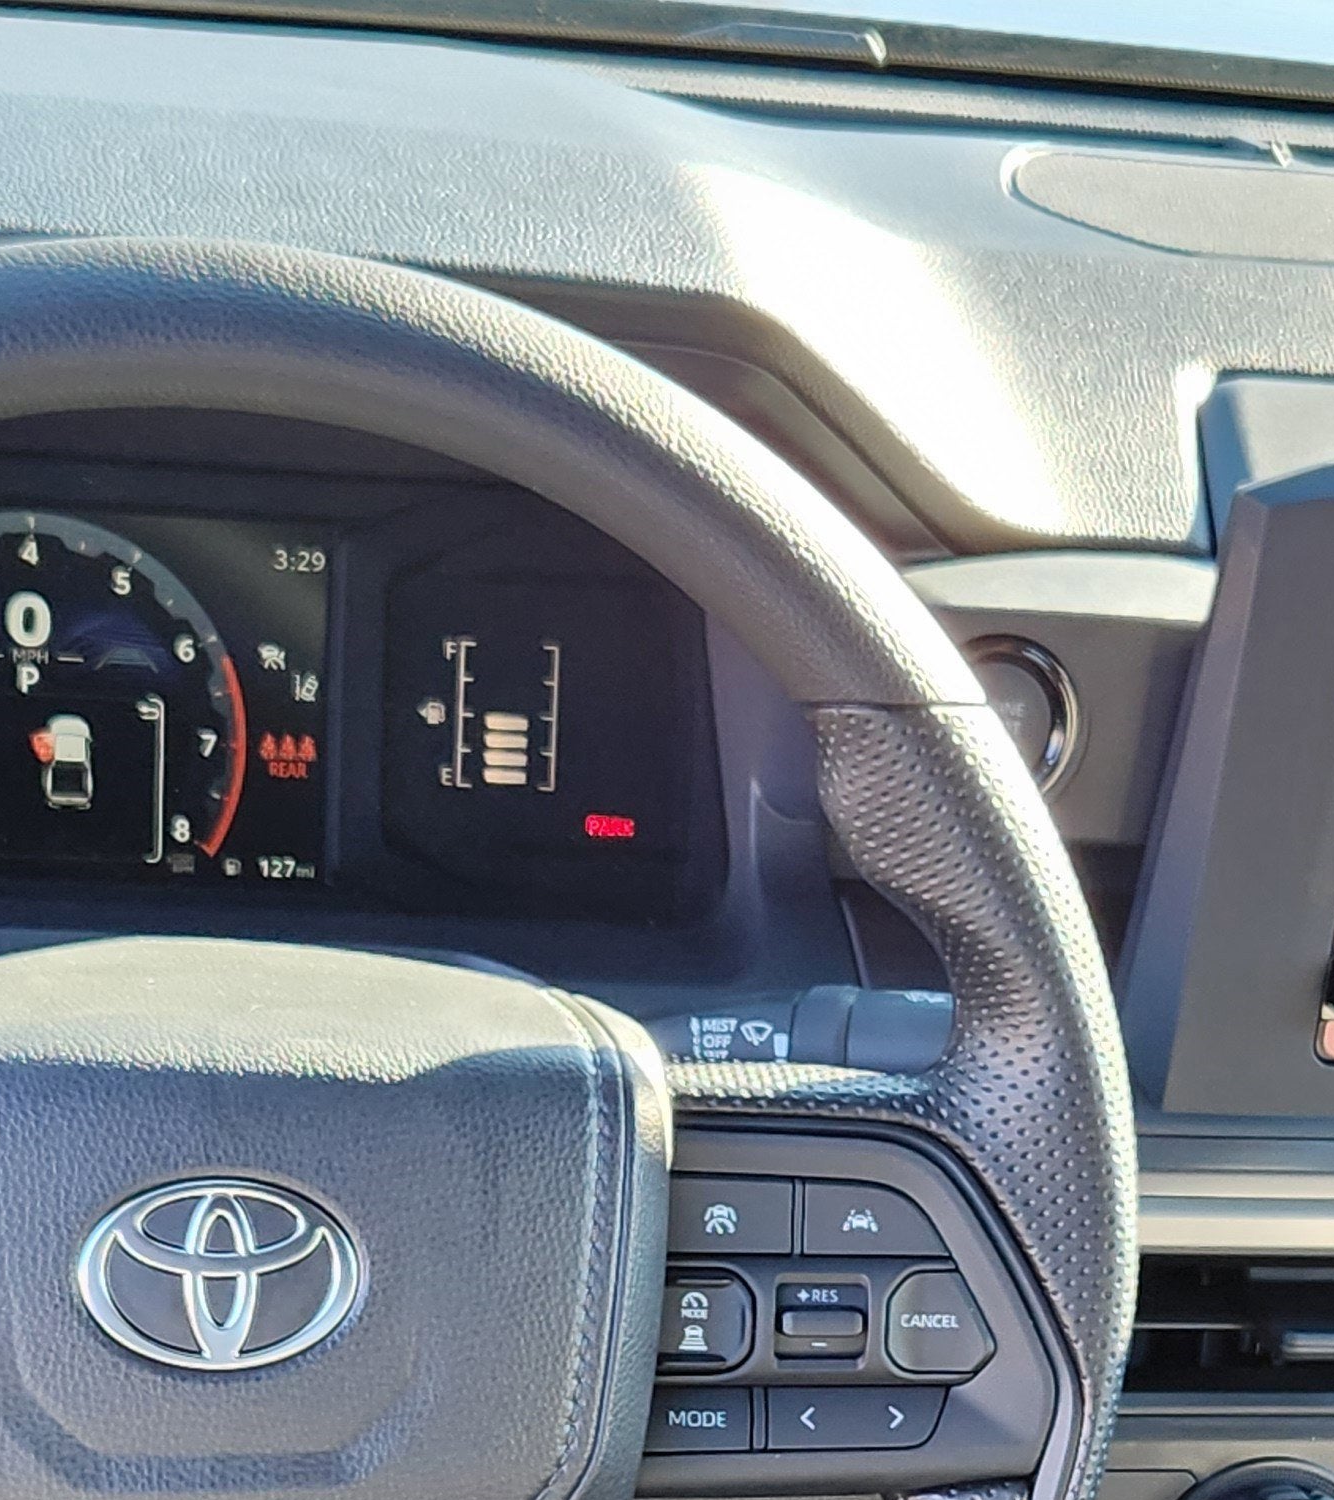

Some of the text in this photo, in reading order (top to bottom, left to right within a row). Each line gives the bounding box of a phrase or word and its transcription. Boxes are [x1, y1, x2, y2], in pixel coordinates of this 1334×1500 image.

[18, 537, 39, 566] 4
[274, 549, 326, 573] 3:29
[113, 567, 132, 595] 5
[5, 591, 51, 647] 0
[12, 650, 49, 664] MPH
[175, 635, 195, 663] 6
[16, 664, 40, 694] P
[198, 730, 217, 758] 7
[269, 761, 309, 779] REAR
[440, 766, 453, 786] E
[172, 815, 191, 843] 8
[702, 1017, 738, 1033] MIST
[702, 1034, 732, 1049] OFF
[900, 1313, 960, 1330] CANCEL
[668, 1409, 728, 1429] MODE
